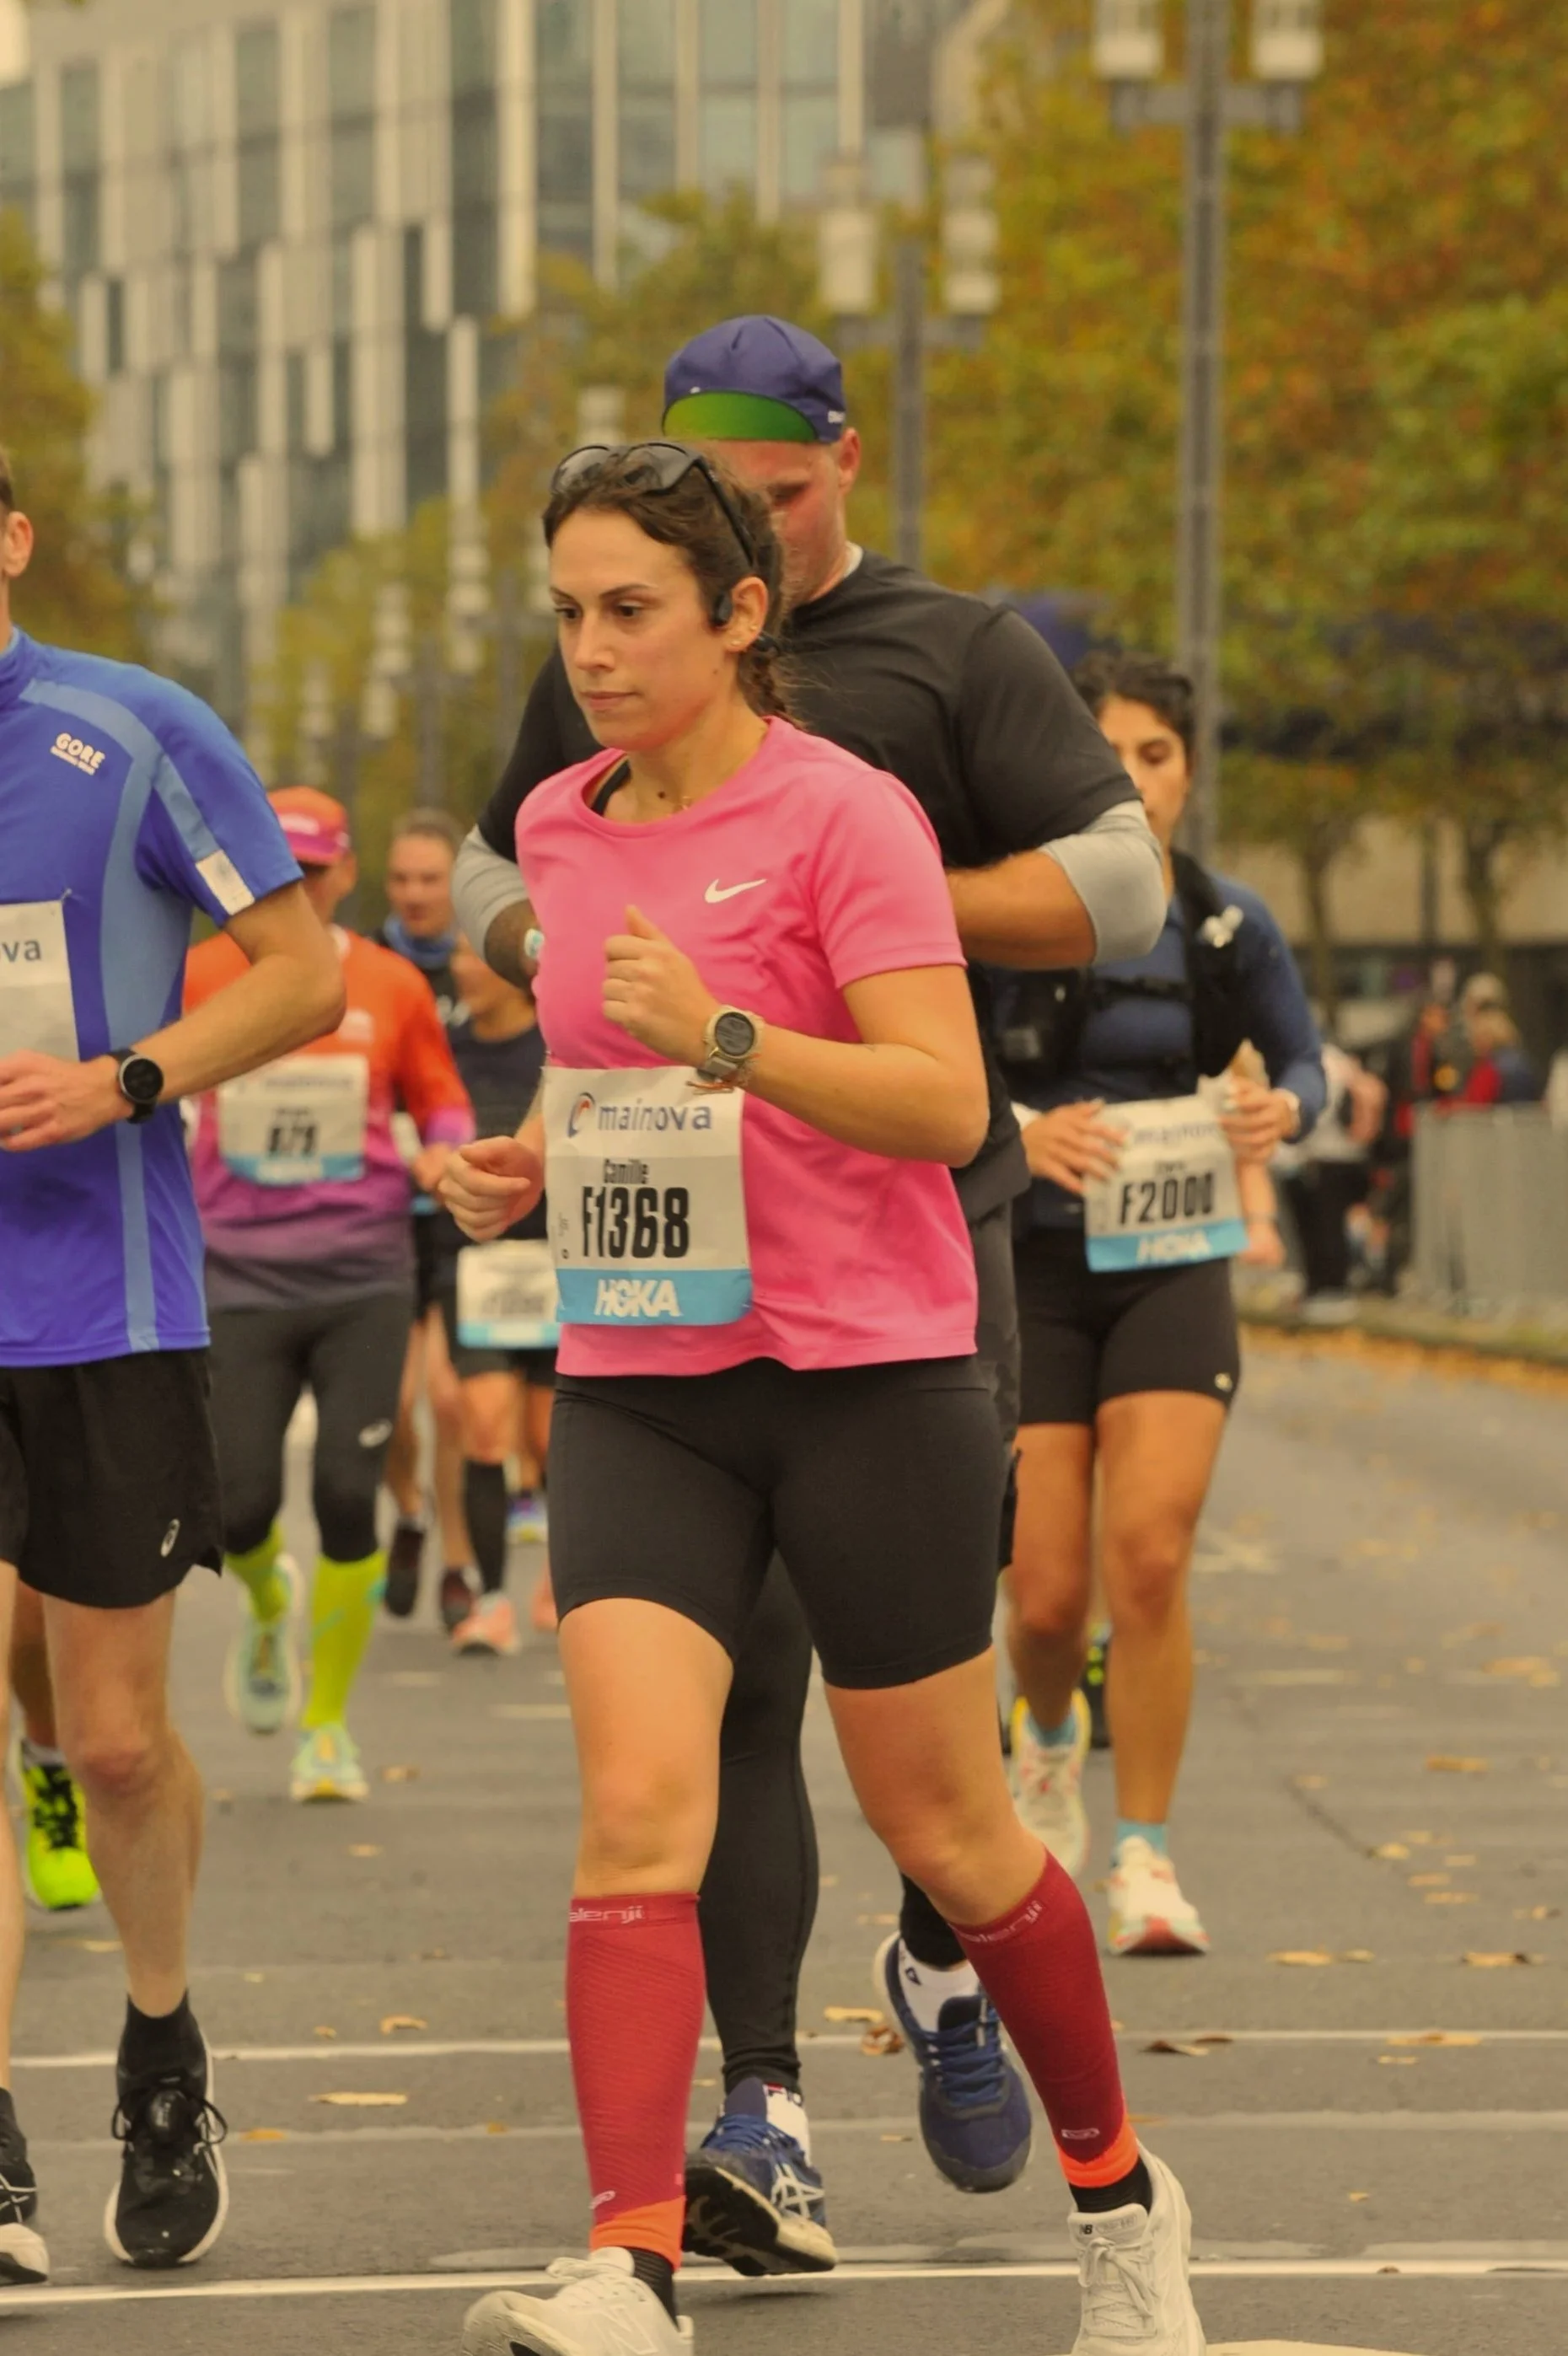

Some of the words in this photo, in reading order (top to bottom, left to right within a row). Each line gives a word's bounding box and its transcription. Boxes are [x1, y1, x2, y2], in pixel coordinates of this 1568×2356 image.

[56, 733, 105, 770] GORE
[0, 939, 42, 963] va
[598, 1097, 712, 1132] mainova
[583, 1186, 690, 1259] F1368
[593, 1279, 682, 1318] HOKA
